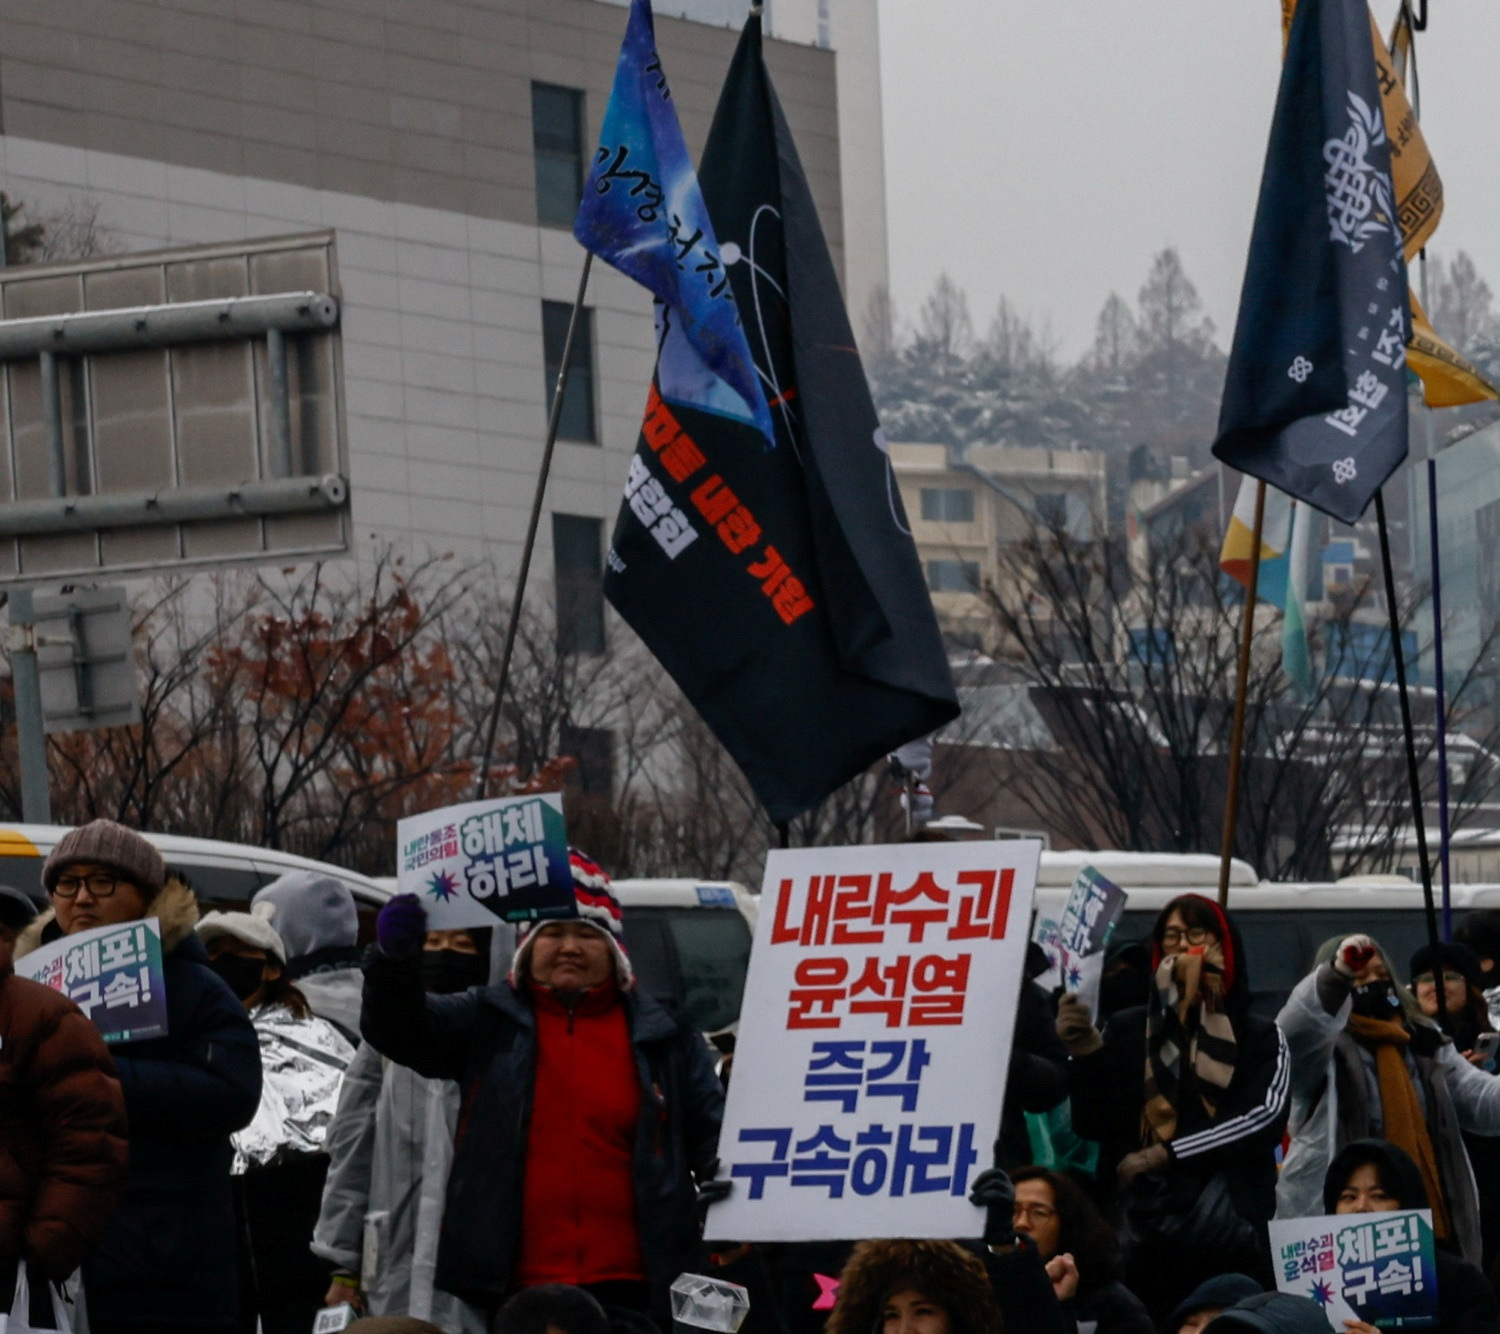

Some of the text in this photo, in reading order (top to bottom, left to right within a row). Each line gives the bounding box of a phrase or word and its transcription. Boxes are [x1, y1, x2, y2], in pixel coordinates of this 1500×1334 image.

[403, 823, 458, 858] 내란동조
[458, 802, 546, 861] 해체
[467, 844, 550, 902] 하라
[770, 867, 1016, 948] 내란수괴
[66, 921, 149, 982] 체포!
[786, 953, 973, 1031] 윤석열
[803, 1038, 931, 1114] 즉각
[730, 1122, 978, 1200] 구속하라
[1282, 1235, 1335, 1263] 내란수괴
[1283, 1250, 1336, 1284] 윤석열
[1338, 1216, 1421, 1267] 체포!
[1343, 1257, 1424, 1307] 구속!
